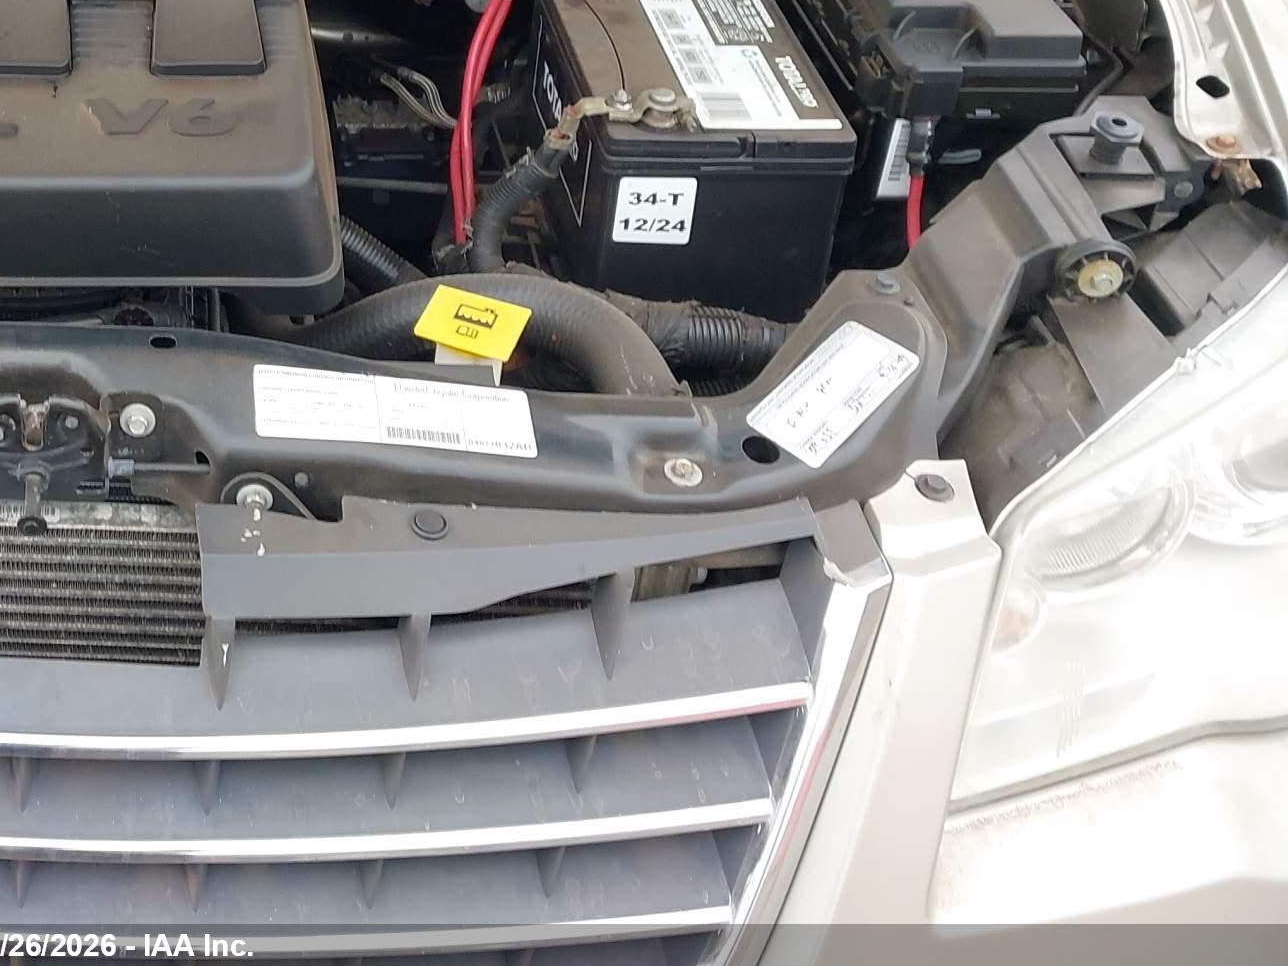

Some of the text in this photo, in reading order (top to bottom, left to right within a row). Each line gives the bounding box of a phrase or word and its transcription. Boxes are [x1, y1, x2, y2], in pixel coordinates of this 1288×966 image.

[85, 98, 239, 138] V6
[628, 192, 684, 206] 34-T
[619, 217, 687, 233] 12/24
